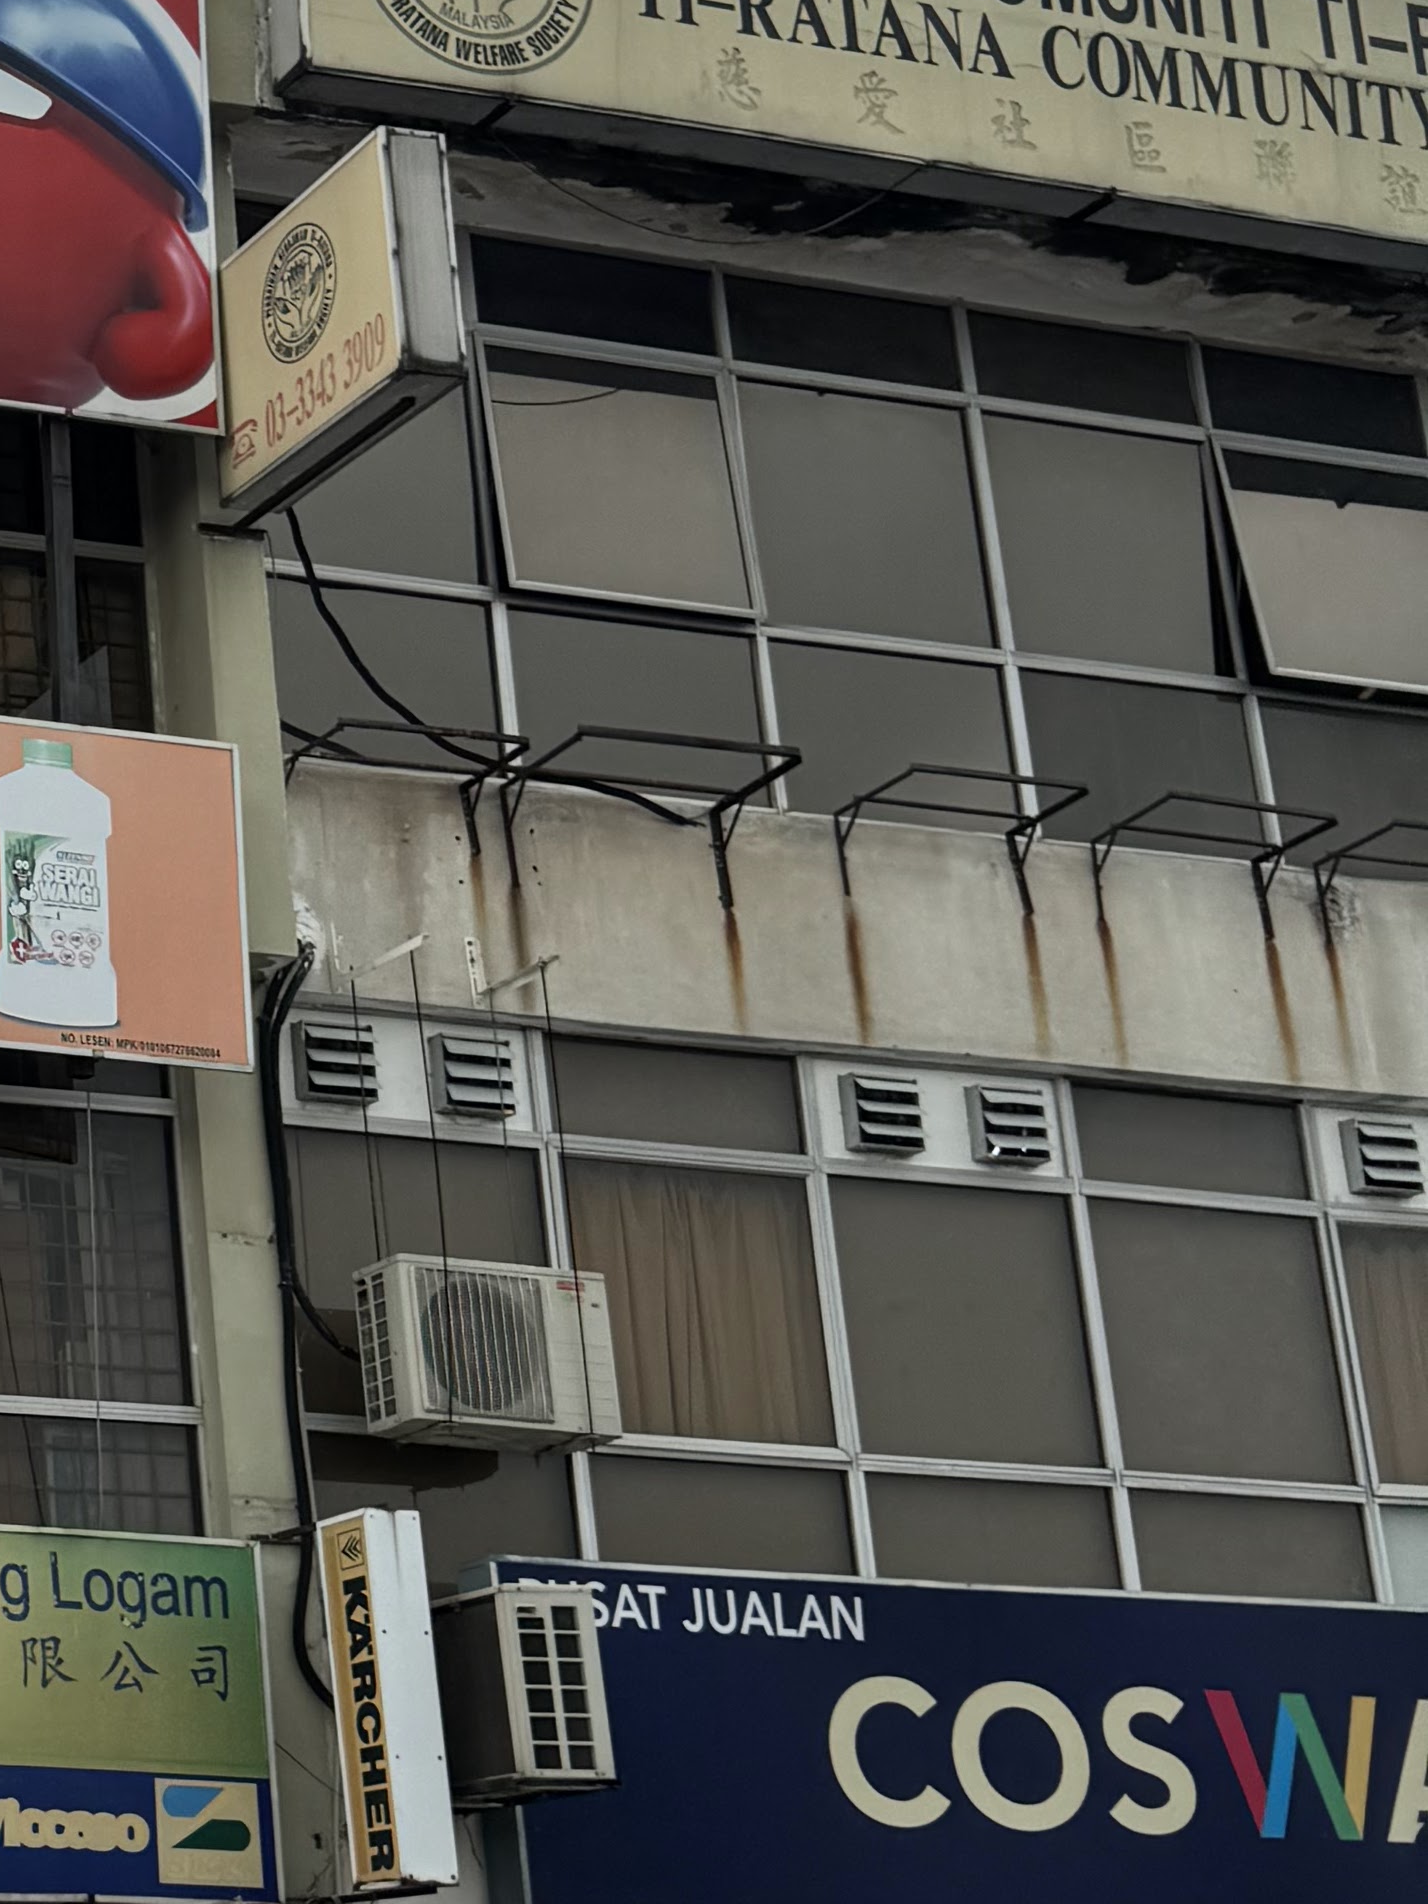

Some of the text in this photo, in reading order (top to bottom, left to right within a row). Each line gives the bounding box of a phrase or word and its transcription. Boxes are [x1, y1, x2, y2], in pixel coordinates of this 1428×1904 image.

[439, 1, 515, 31] MALAYSIA
[455, 36, 530, 67] WELFARE
[265, 312, 386, 448] 03-3343 3909
[41, 862, 97, 888] SERAI
[39, 880, 101, 908] WANGI
[61, 1032, 76, 1043] NO.
[80, 1034, 113, 1047] LESEN:
[52, 1549, 231, 1629] Logam
[682, 1587, 865, 1641] JUALAN
[343, 1575, 394, 1872] KÄRCHER
